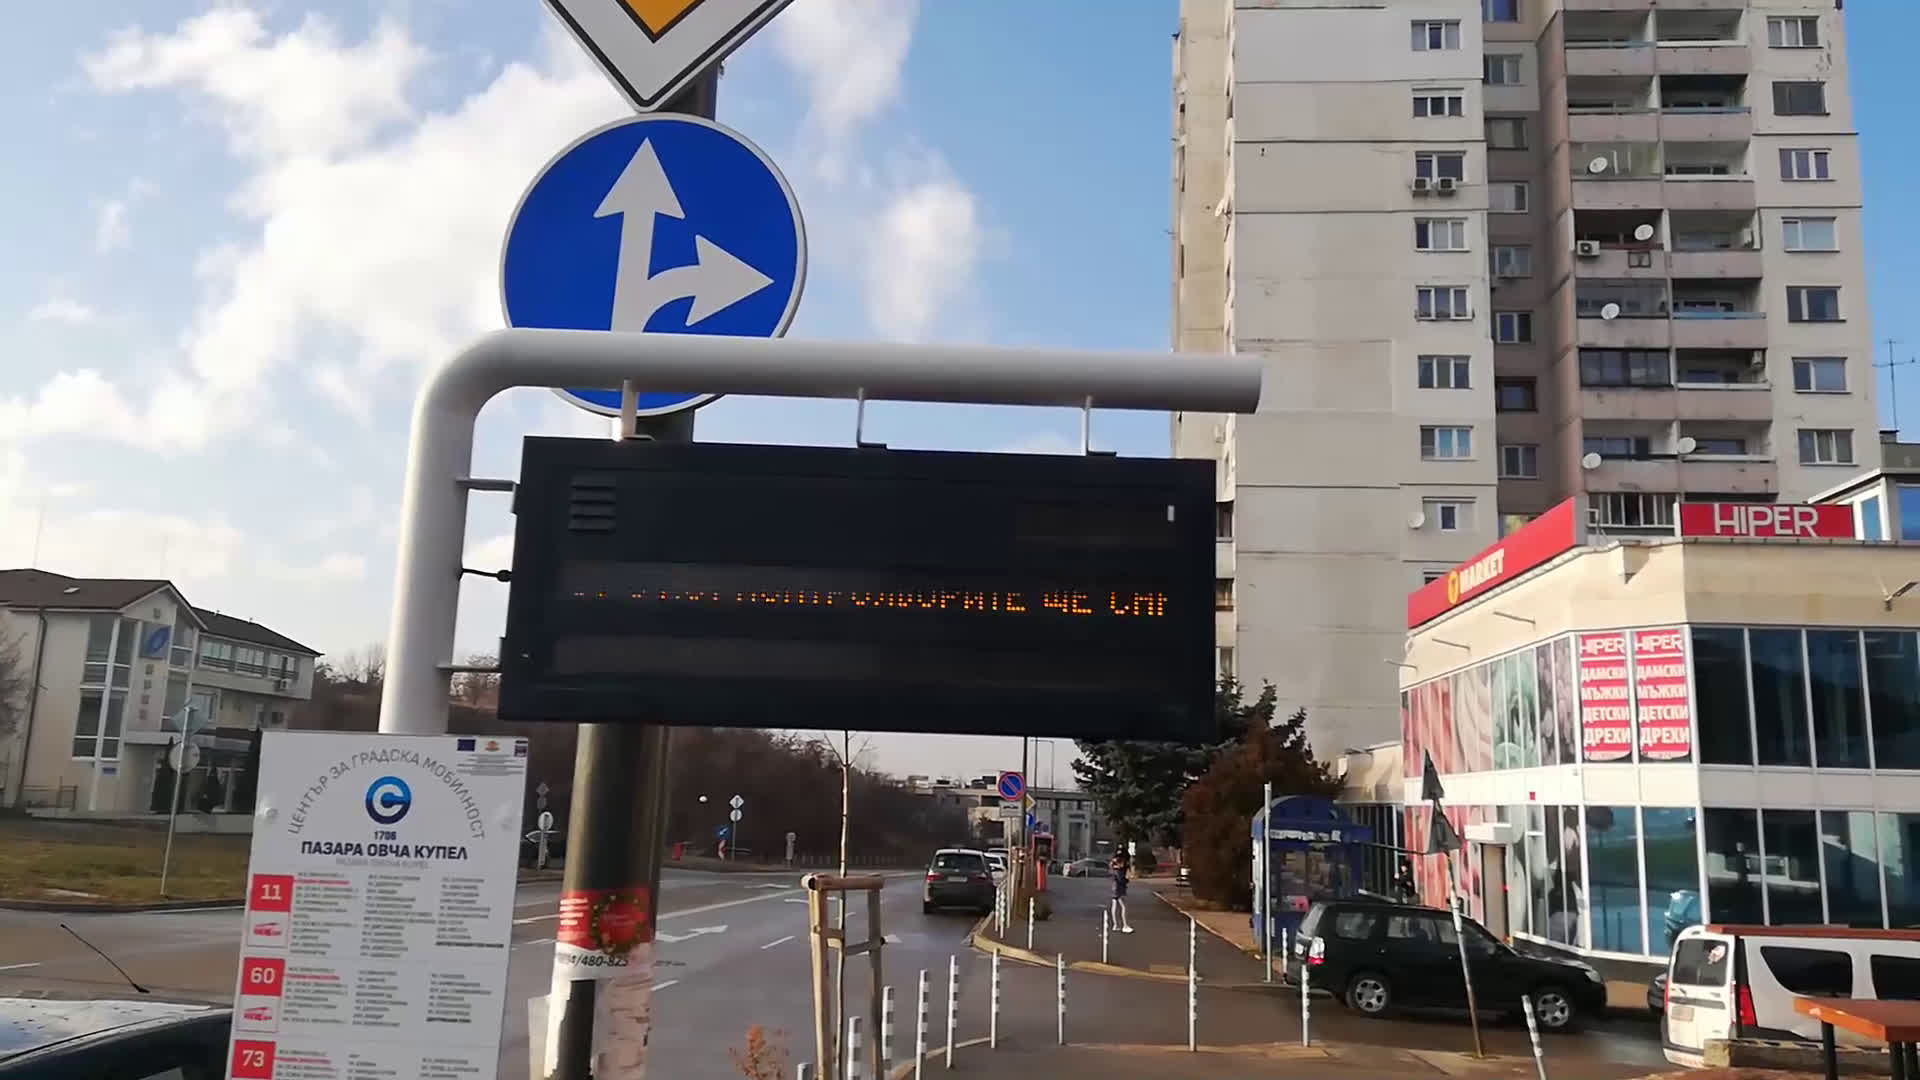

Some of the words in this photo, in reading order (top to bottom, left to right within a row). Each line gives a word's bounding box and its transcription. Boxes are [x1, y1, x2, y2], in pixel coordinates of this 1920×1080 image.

[1713, 503, 1820, 538] HIPER
[1460, 548, 1504, 595] MARKET
[1580, 637, 1625, 655] HIPER
[1635, 634, 1683, 652] HIPER
[1582, 706, 1630, 723] ДЕТСКИ
[1638, 704, 1689, 723] ДЕТСКИ
[1583, 727, 1631, 747] ДРЕХИ
[1640, 726, 1690, 747] ДРЕХИ
[288, 775, 328, 835] ЦЕНТЪР
[329, 760, 352, 781] ЗА
[351, 748, 420, 769] ГРАДСКА
[423, 757, 485, 841] МОБИЛНОСТ
[301, 840, 364, 858] ПАЗАРА
[366, 843, 411, 858] ОВЧА
[413, 845, 469, 860] КУПЕЛ
[260, 883, 281, 901] 11
[249, 966, 275, 985] 60
[242, 1049, 266, 1068] 73
